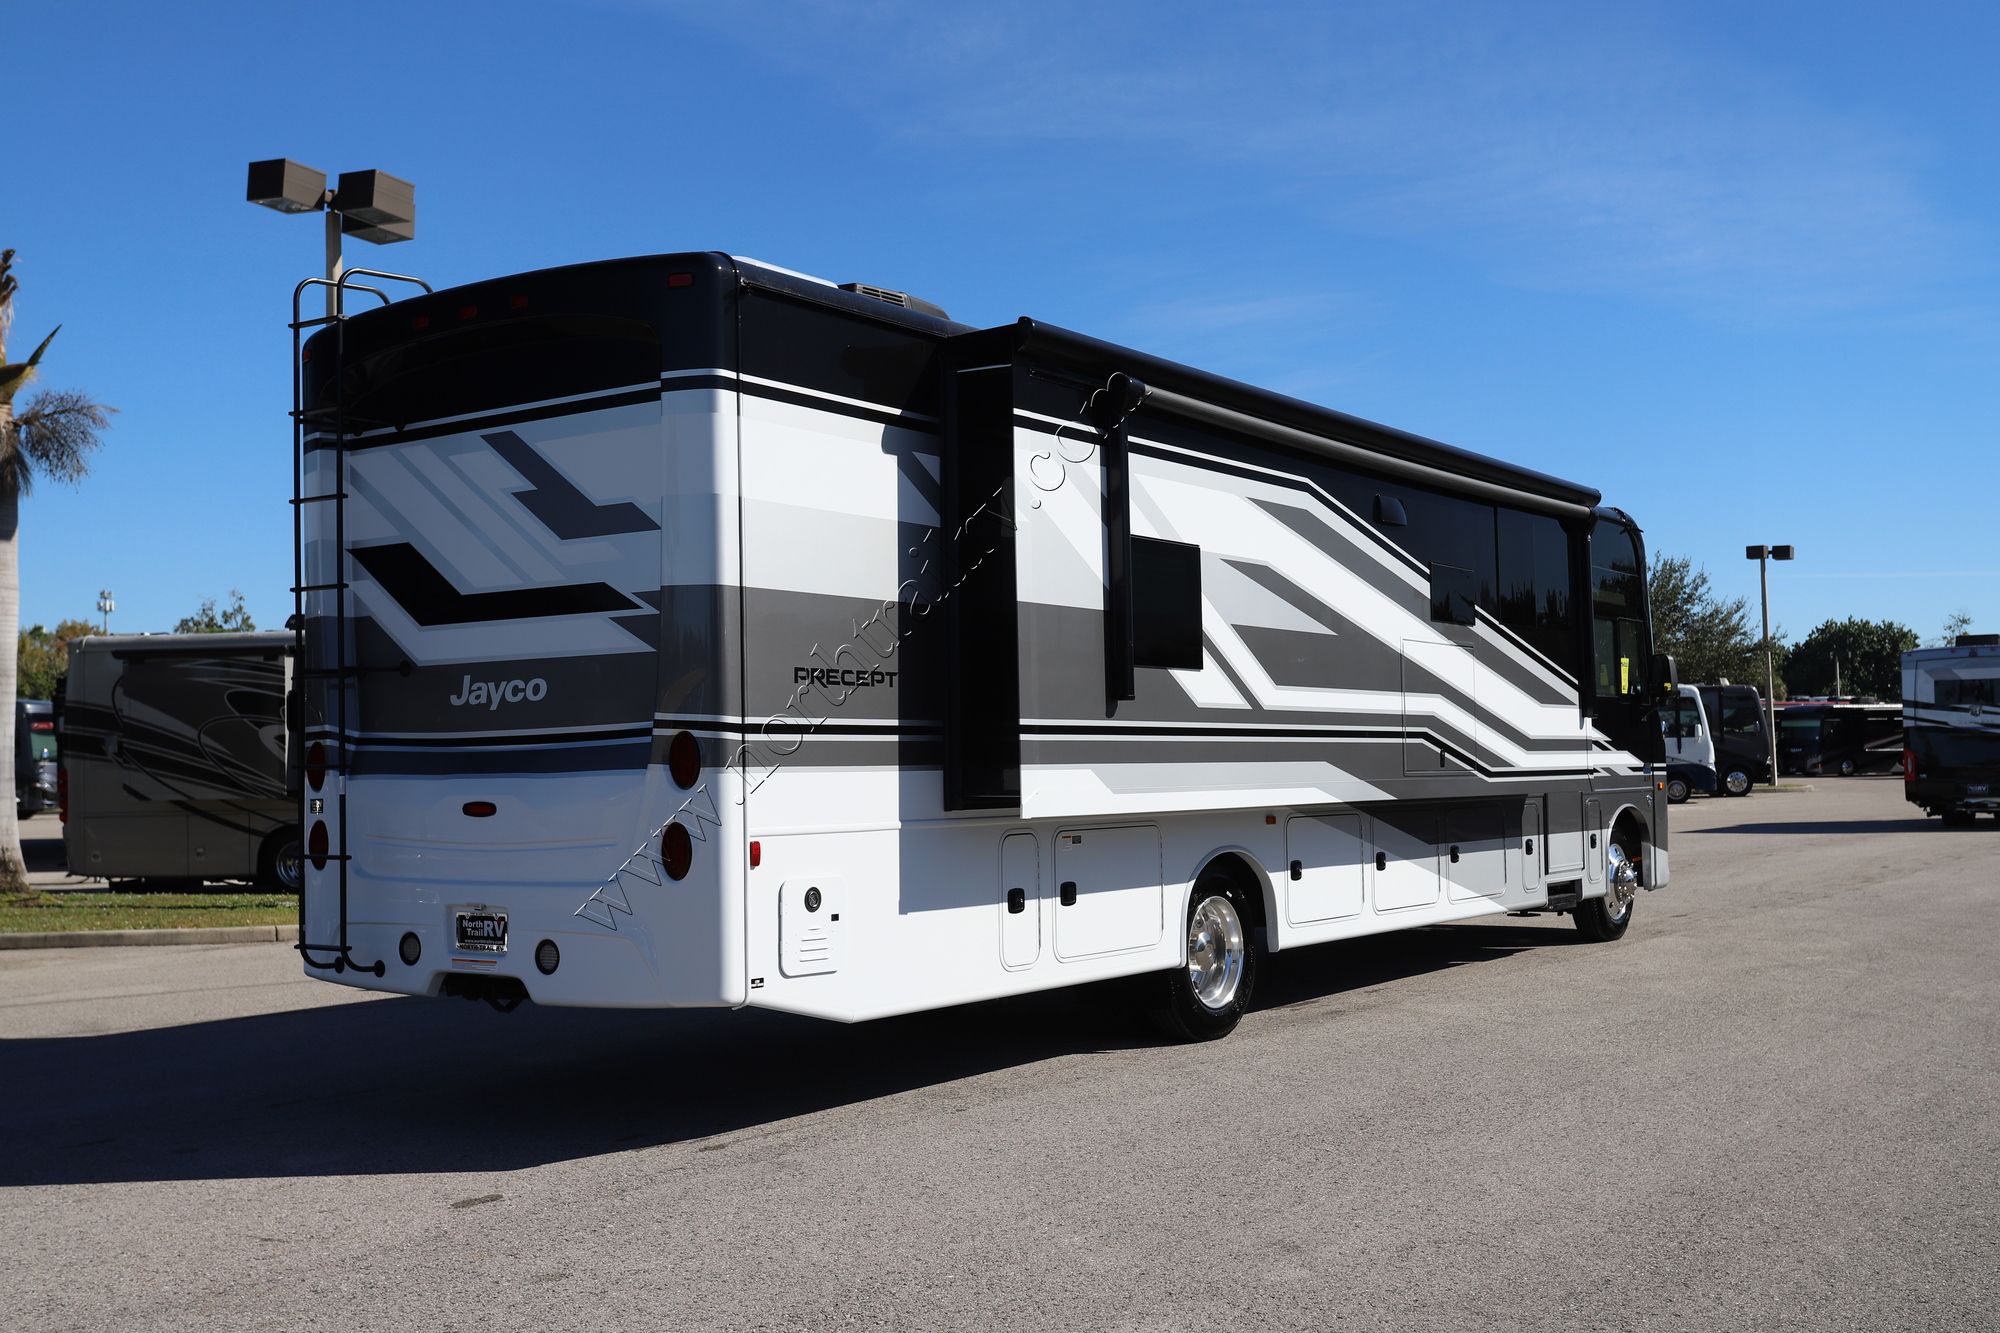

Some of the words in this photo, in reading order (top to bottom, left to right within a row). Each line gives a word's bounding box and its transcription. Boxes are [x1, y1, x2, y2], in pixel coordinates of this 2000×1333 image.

[794, 666, 898, 688] PRECEPT
[450, 674, 548, 711] Jayco
[462, 920, 484, 928] North
[466, 928, 484, 937] Trail
[483, 920, 505, 937] RV
